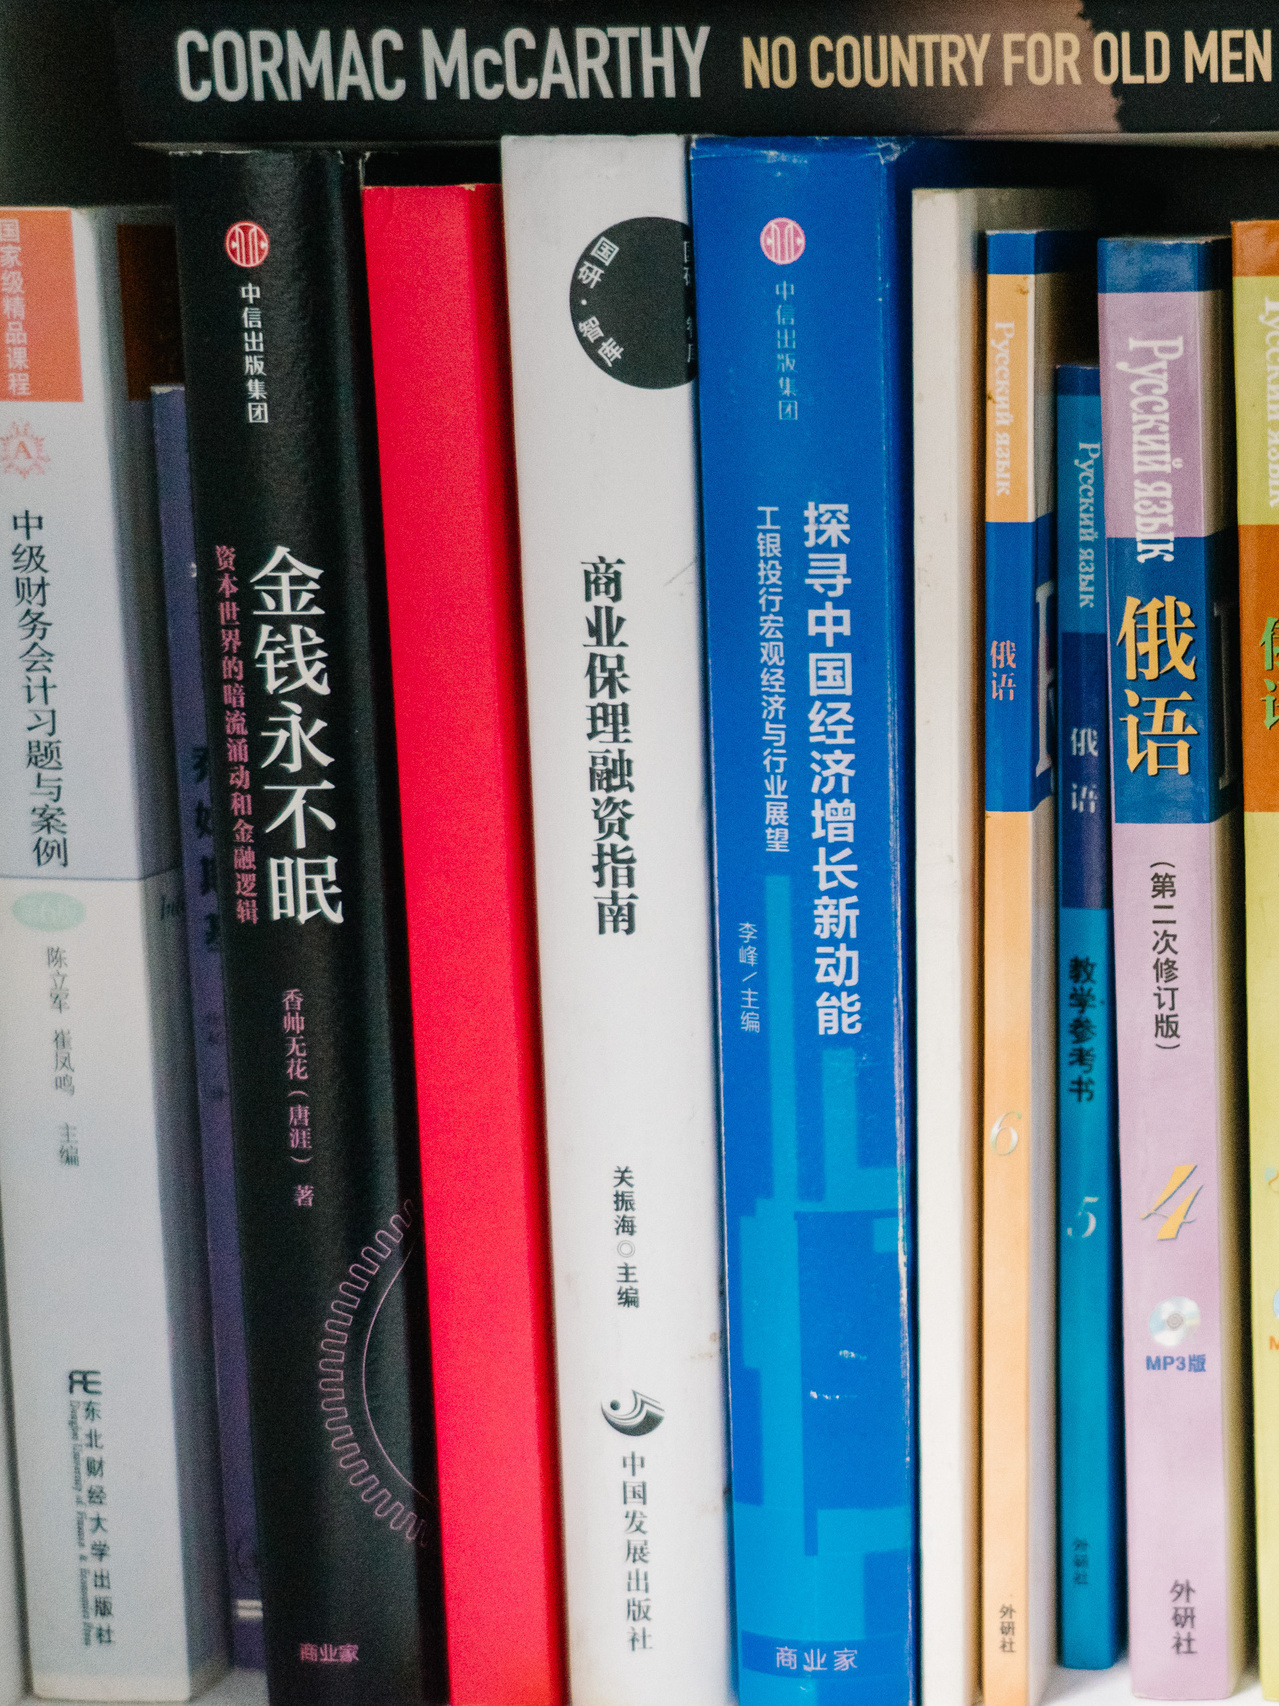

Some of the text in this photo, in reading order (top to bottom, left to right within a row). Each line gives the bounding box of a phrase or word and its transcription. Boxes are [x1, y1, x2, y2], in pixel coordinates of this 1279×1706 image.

[177, 26, 711, 102] CORMAC McCARTHY
[742, 29, 1273, 89] NO COUNTRY FOR OLD MEN
[0, 219, 32, 396] 国家级精品课程
[240, 282, 269, 424] 中信出版集团
[775, 281, 799, 421] 中信出版集团
[991, 321, 1016, 496] Русский язык
[1116, 336, 1185, 564] Русский язык
[1074, 442, 1101, 608] Русский язык
[12, 510, 69, 869] 中级财务会计习题与案例
[215, 544, 260, 925] 资本世界的暗流涌动和金融逻辑
[249, 546, 344, 925] 金钱永不眠
[756, 506, 791, 852] 工银投行宏观经济与行业展望
[990, 640, 1017, 702] 俄语
[1116, 594, 1199, 777] 俄语
[580, 556, 639, 935] 商业保理融资指南
[803, 501, 862, 1036] 探寻中国经济增长新动能
[1070, 728, 1098, 814] 俄语
[1068, 956, 1098, 1103] 教学参考书
[58, 1121, 80, 1167] 主编
[294, 1184, 314, 1208] 著
[989, 1111, 1023, 1157] 6
[1140, 1164, 1204, 1242] 4
[1067, 1196, 1099, 1239] 5
[1145, 1354, 1207, 1373] MP3版
[84, 1400, 115, 1644] 东北财经大学出版社
[621, 1450, 653, 1653] 中国发展出版社
[299, 1643, 360, 1664] 商业家
[776, 1645, 859, 1673] 商业家
[999, 1604, 1017, 1654] 外研社
[1170, 1578, 1198, 1655] 外研社
